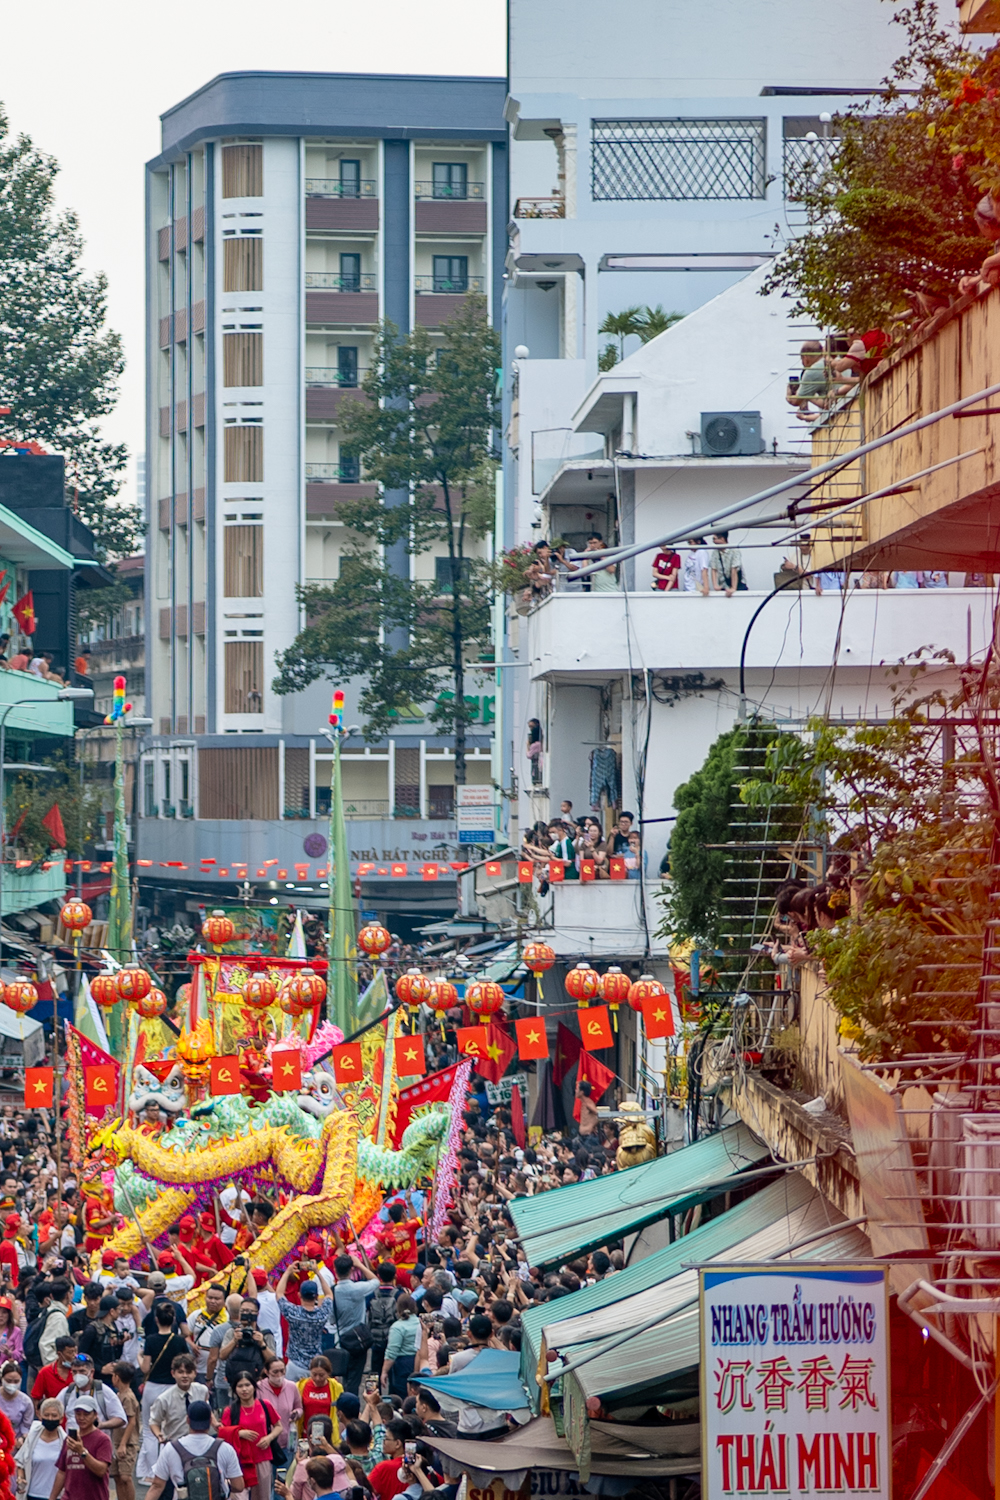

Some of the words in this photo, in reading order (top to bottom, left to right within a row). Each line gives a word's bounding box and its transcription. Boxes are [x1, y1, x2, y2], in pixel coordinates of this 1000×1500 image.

[350, 847, 379, 861] NHÀ
[382, 847, 410, 861] HÁT
[412, 847, 450, 862] NGHỆ
[710, 1303, 768, 1344] NHANG
[713, 1353, 878, 1413] 沉香香氣
[716, 1420, 789, 1494] THÁI
[796, 1432, 880, 1492] MINH
